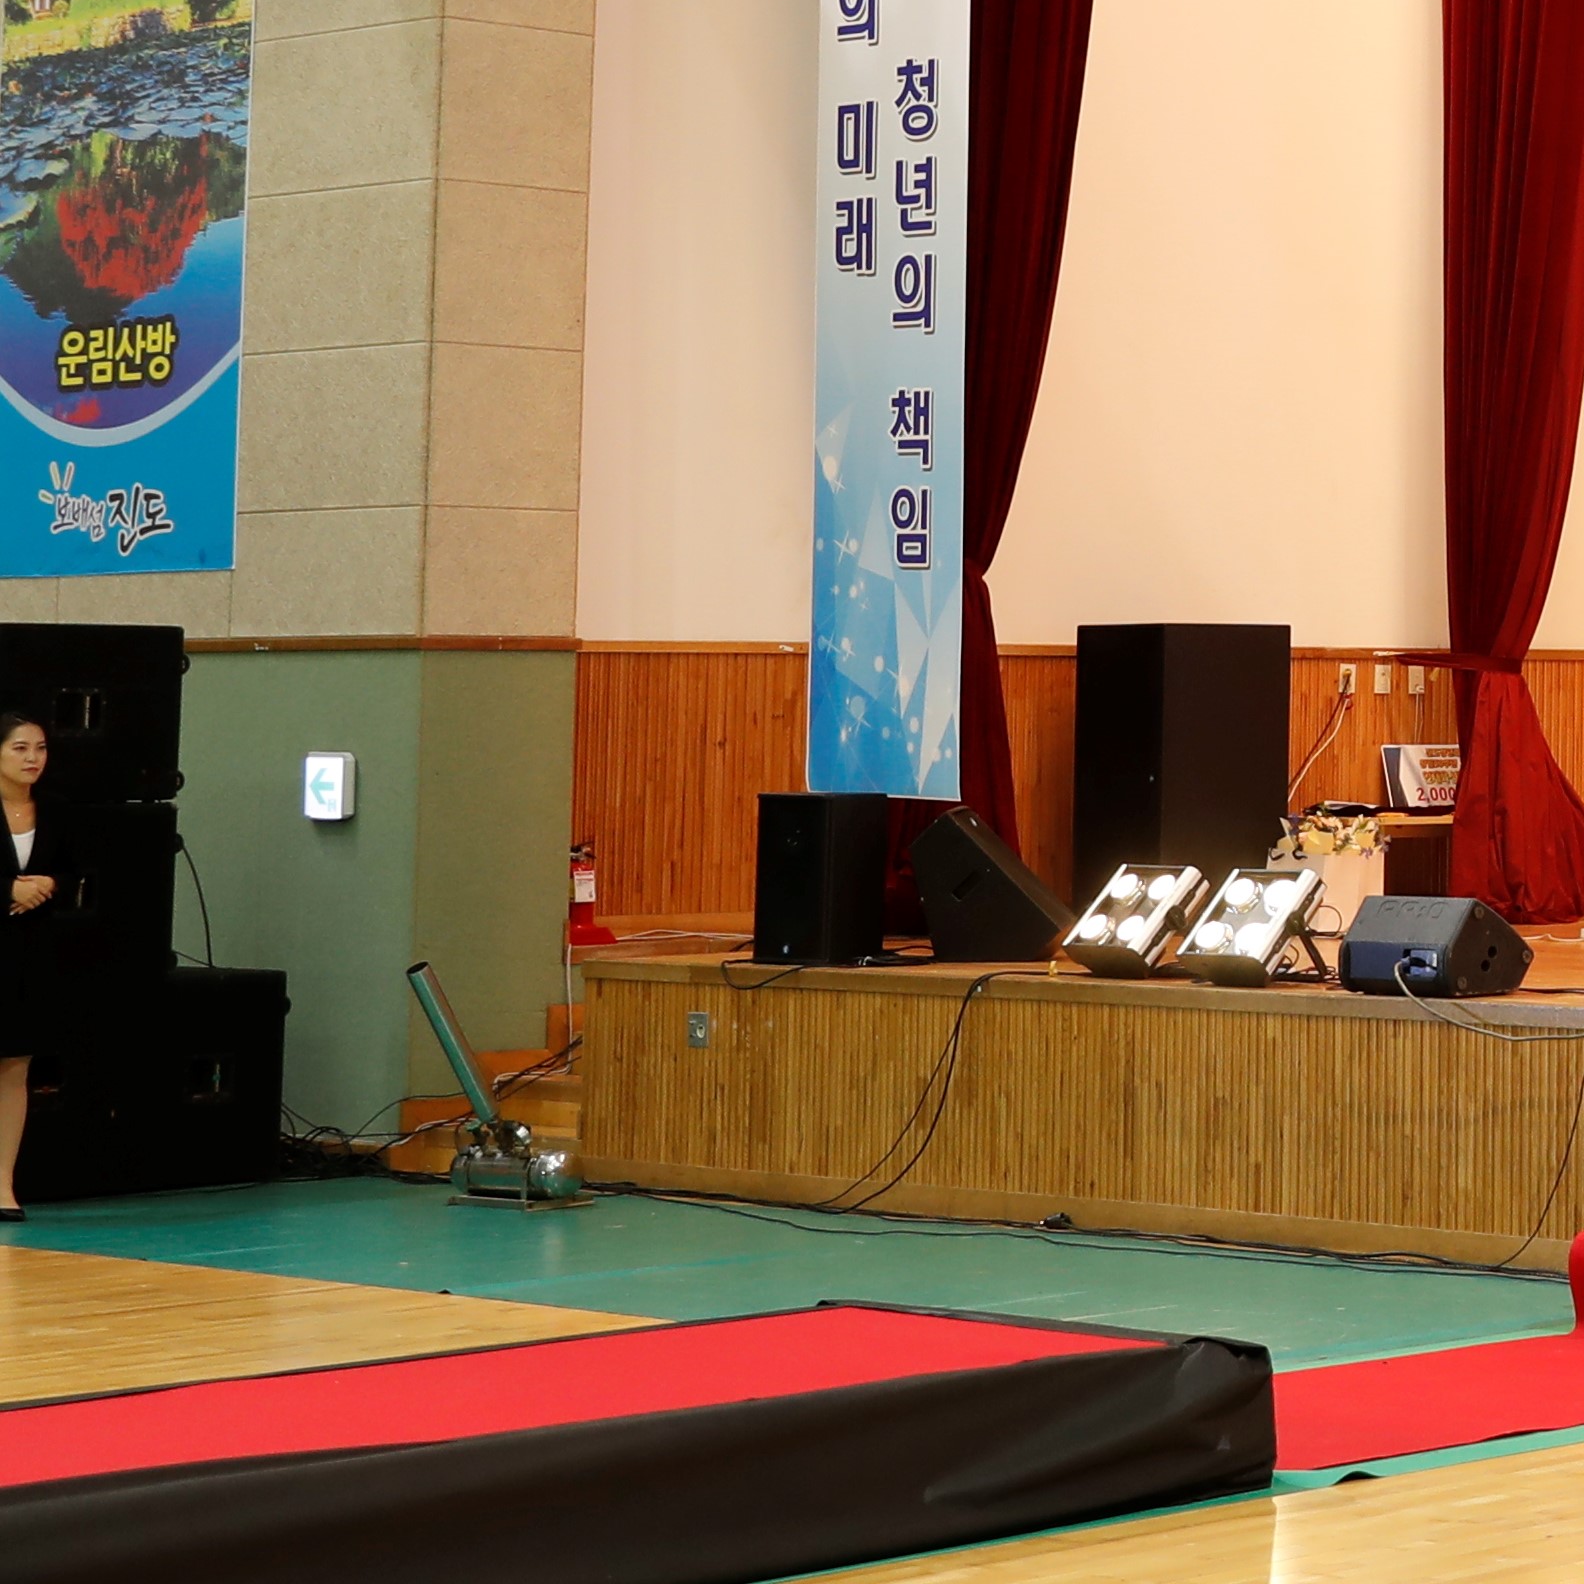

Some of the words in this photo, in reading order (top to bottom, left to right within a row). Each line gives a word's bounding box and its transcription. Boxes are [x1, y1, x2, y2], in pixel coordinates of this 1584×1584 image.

[835, 99, 879, 275] 미래
[891, 56, 939, 334] 청년의
[57, 320, 177, 387] 운림산방
[107, 482, 173, 556] 진도
[889, 388, 933, 570] 책임
